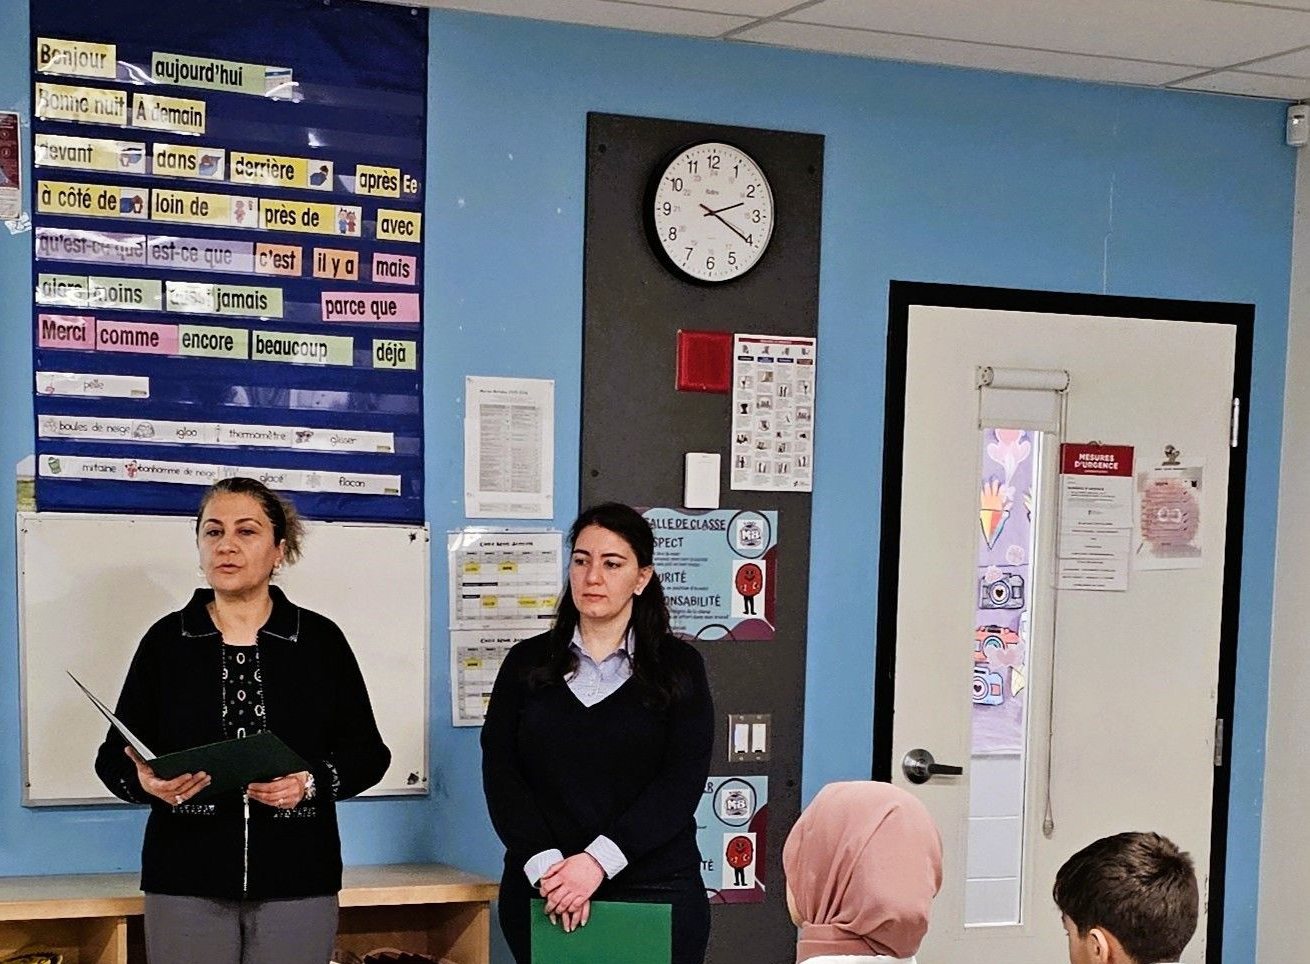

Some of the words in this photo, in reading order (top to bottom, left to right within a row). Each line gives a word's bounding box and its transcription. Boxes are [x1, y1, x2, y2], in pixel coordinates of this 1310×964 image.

[41, 43, 107, 72] Bonjour
[155, 59, 243, 86] aujourd'hui
[95, 95, 125, 117] nuit
[136, 96, 147, 121] À
[151, 102, 203, 127] demain
[41, 140, 94, 163] devant
[157, 150, 197, 170] dans
[235, 156, 295, 180] derrière
[688, 160, 698, 174] 11
[707, 155, 721, 170] 12
[734, 165, 739, 178] 1
[359, 170, 398, 193] après
[670, 177, 683, 192] 10
[746, 184, 756, 199] 2
[42, 184, 52, 206] à
[58, 186, 92, 208] côté
[98, 190, 117, 211] de
[156, 193, 184, 214] loin
[190, 196, 209, 217] de
[265, 204, 296, 228] près
[301, 209, 320, 227] de
[663, 201, 671, 216] 9
[752, 209, 761, 224] 3
[381, 217, 414, 236] avec
[668, 227, 677, 241] 8
[745, 234, 753, 247] 4
[152, 241, 198, 263] est-ce
[204, 246, 233, 268] que
[259, 250, 296, 271] c'est
[684, 247, 694, 261] 7
[706, 256, 715, 270] 6
[727, 251, 737, 265] 5
[317, 253, 326, 272] il
[331, 261, 340, 278] y
[345, 259, 354, 275] a
[376, 258, 411, 278] mais
[216, 288, 268, 312] jamais
[325, 299, 366, 319] parce
[371, 300, 397, 320] que
[42, 319, 86, 342] Merci
[100, 327, 160, 347] comme
[182, 331, 234, 351] encore
[256, 335, 328, 362] beaucoup
[376, 343, 406, 366] déjà
[92, 420, 103, 432] de
[1078, 453, 1115, 462] MESURES
[675, 518, 688, 531] DE
[690, 519, 726, 531] CLASSE
[653, 537, 684, 548] SPECT
[659, 571, 687, 584] URITÉ
[664, 594, 721, 607] ONSABILITÉ
